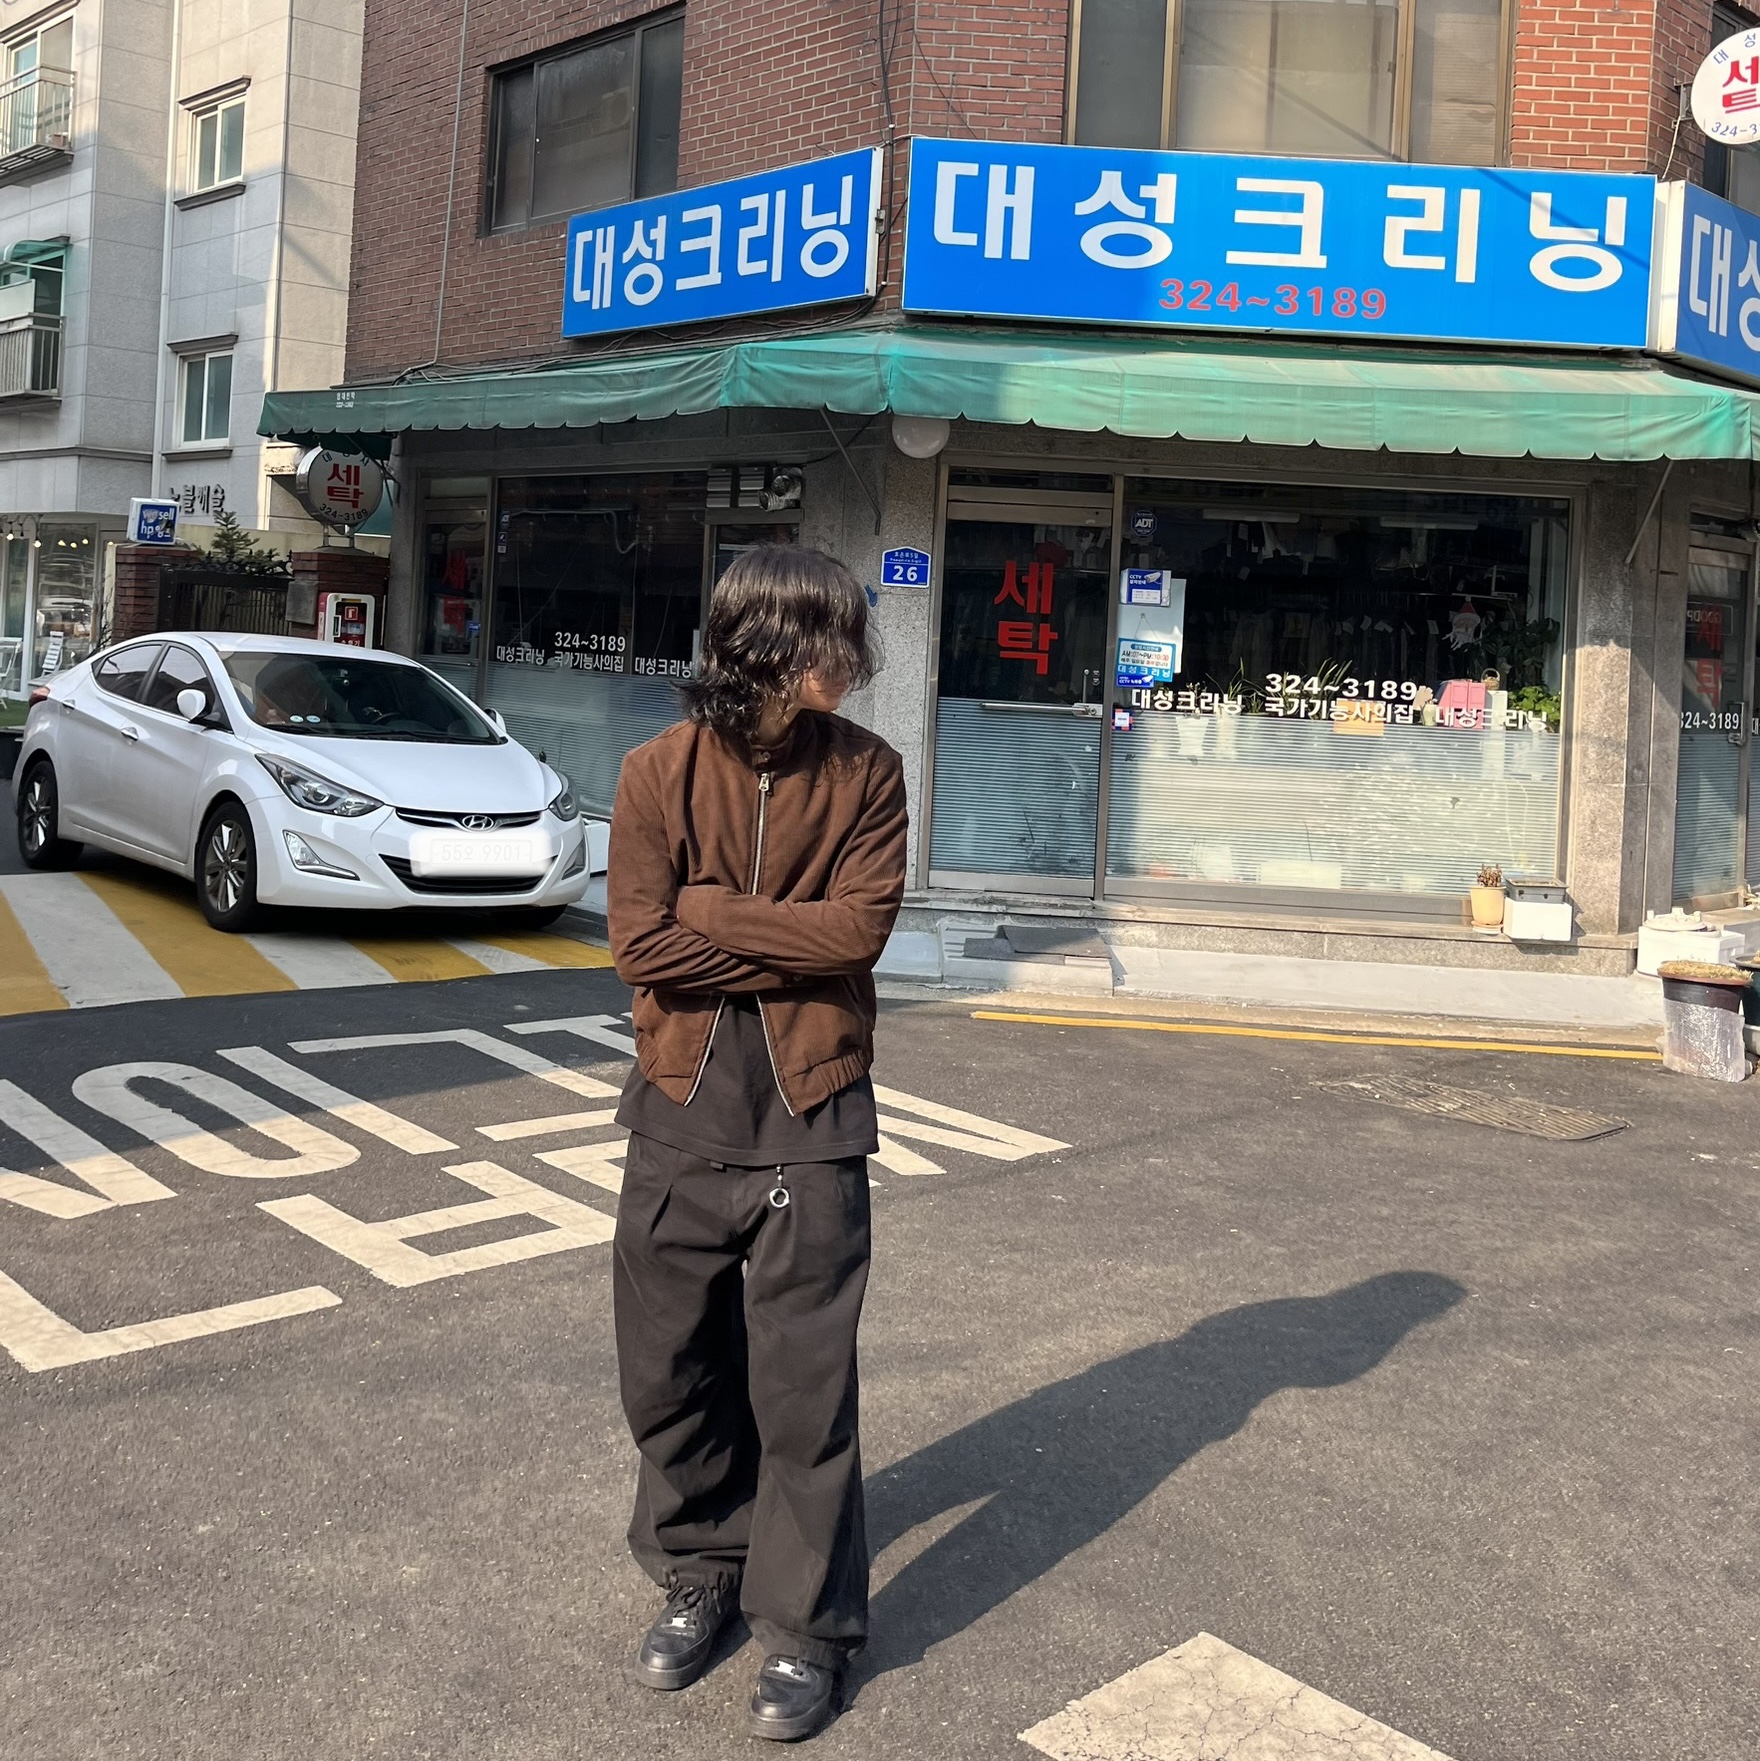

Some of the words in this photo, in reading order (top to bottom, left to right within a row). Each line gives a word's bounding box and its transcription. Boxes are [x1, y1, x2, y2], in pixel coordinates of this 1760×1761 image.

[1711, 121, 1760, 137] 324-3
[934, 161, 1627, 293] 대성크리닝
[573, 175, 853, 310] 대성크리닝
[322, 451, 371, 467] 대사
[327, 463, 364, 508] 세탁
[158, 508, 175, 520] sell
[320, 503, 368, 521] 324-3189
[141, 520, 154, 539] hp
[1134, 518, 1154, 528] ADT
[893, 565, 917, 581] 26
[994, 560, 1058, 675] 세탁
[554, 631, 626, 652] 324~3189
[496, 645, 545, 665] 대성크리닝
[554, 651, 624, 672] 국가기능사의집
[634, 656, 692, 679] 대성크리닝
[1118, 665, 1170, 678] 대성크리닝
[1265, 673, 1418, 701] 324~3189
[1132, 688, 1243, 714] 대성크리닝
[1265, 697, 1414, 725] 국가기능사의집
